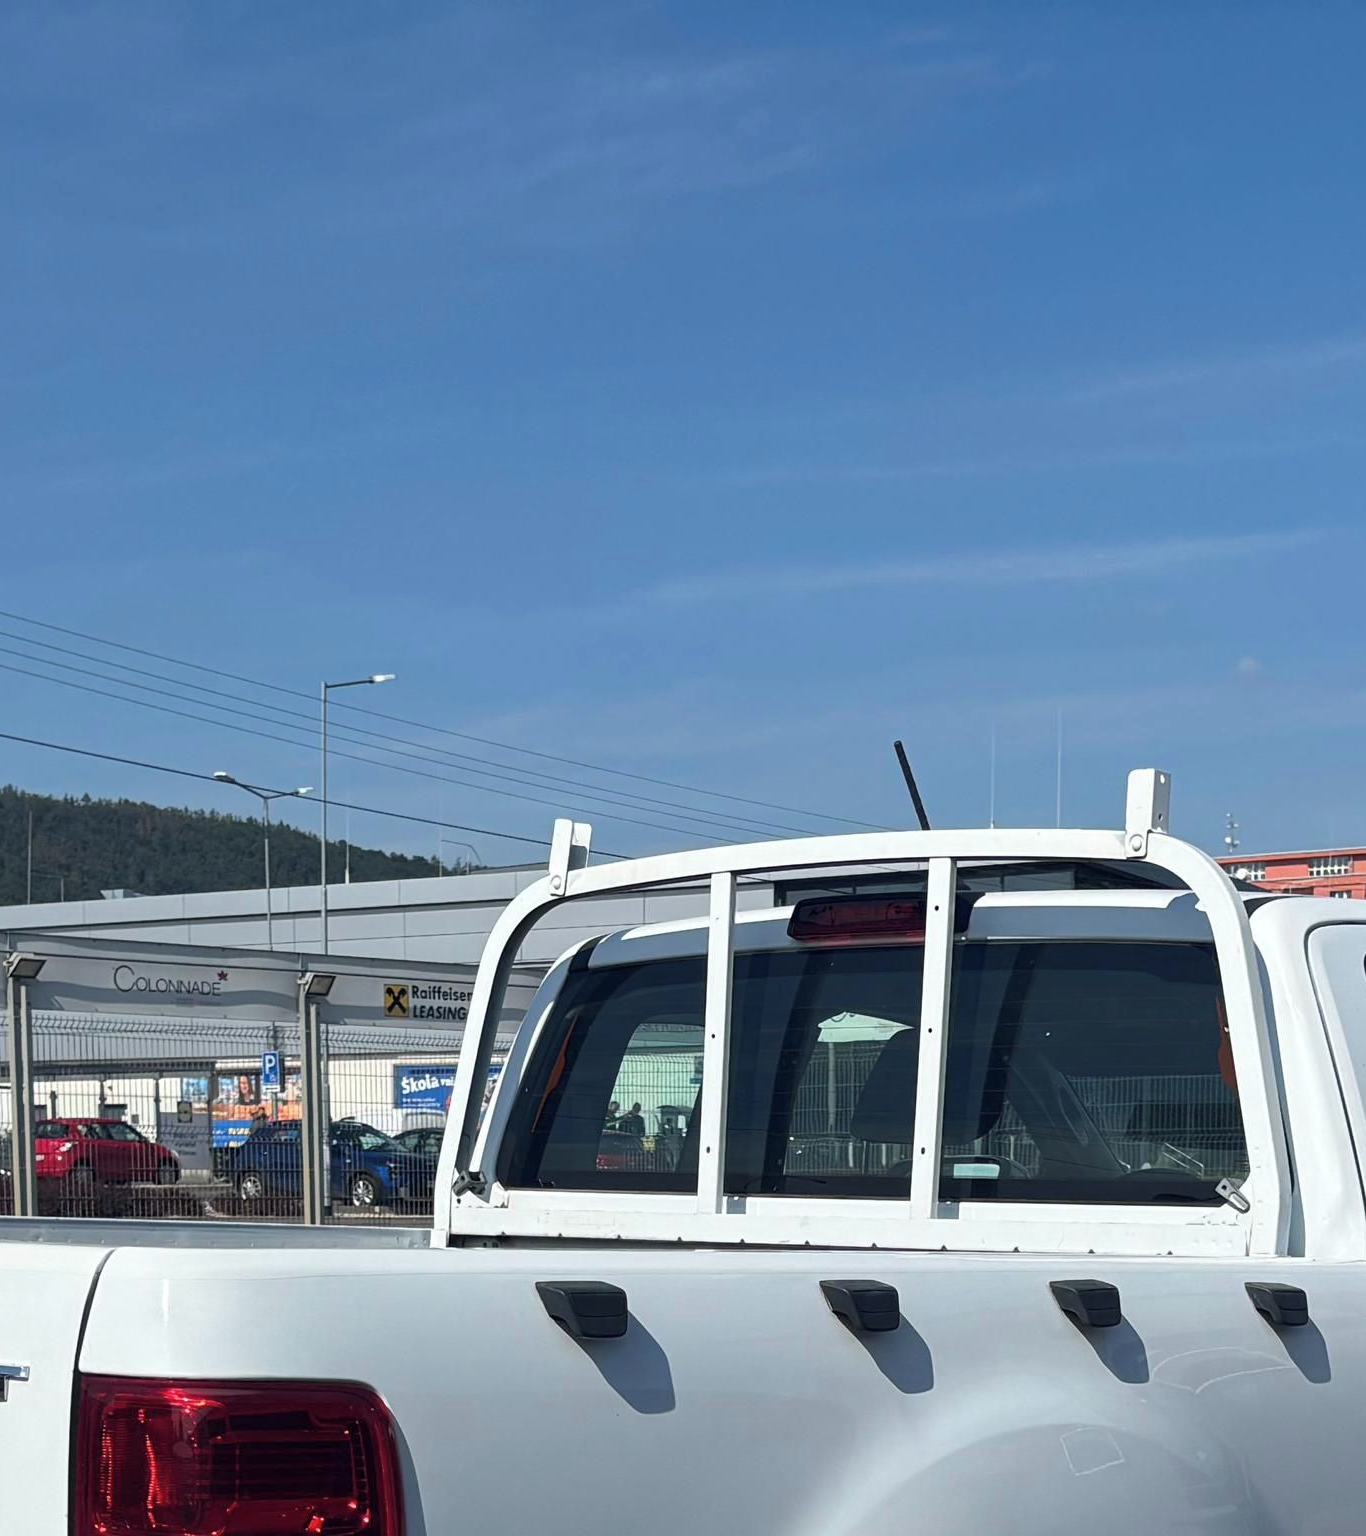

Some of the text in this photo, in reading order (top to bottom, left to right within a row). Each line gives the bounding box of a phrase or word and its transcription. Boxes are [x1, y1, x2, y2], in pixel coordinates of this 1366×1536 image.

[114, 965, 221, 996] COLONNADE
[413, 1005, 467, 1020] LEASING
[265, 1055, 275, 1074] P
[402, 1074, 439, 1095] Škola
